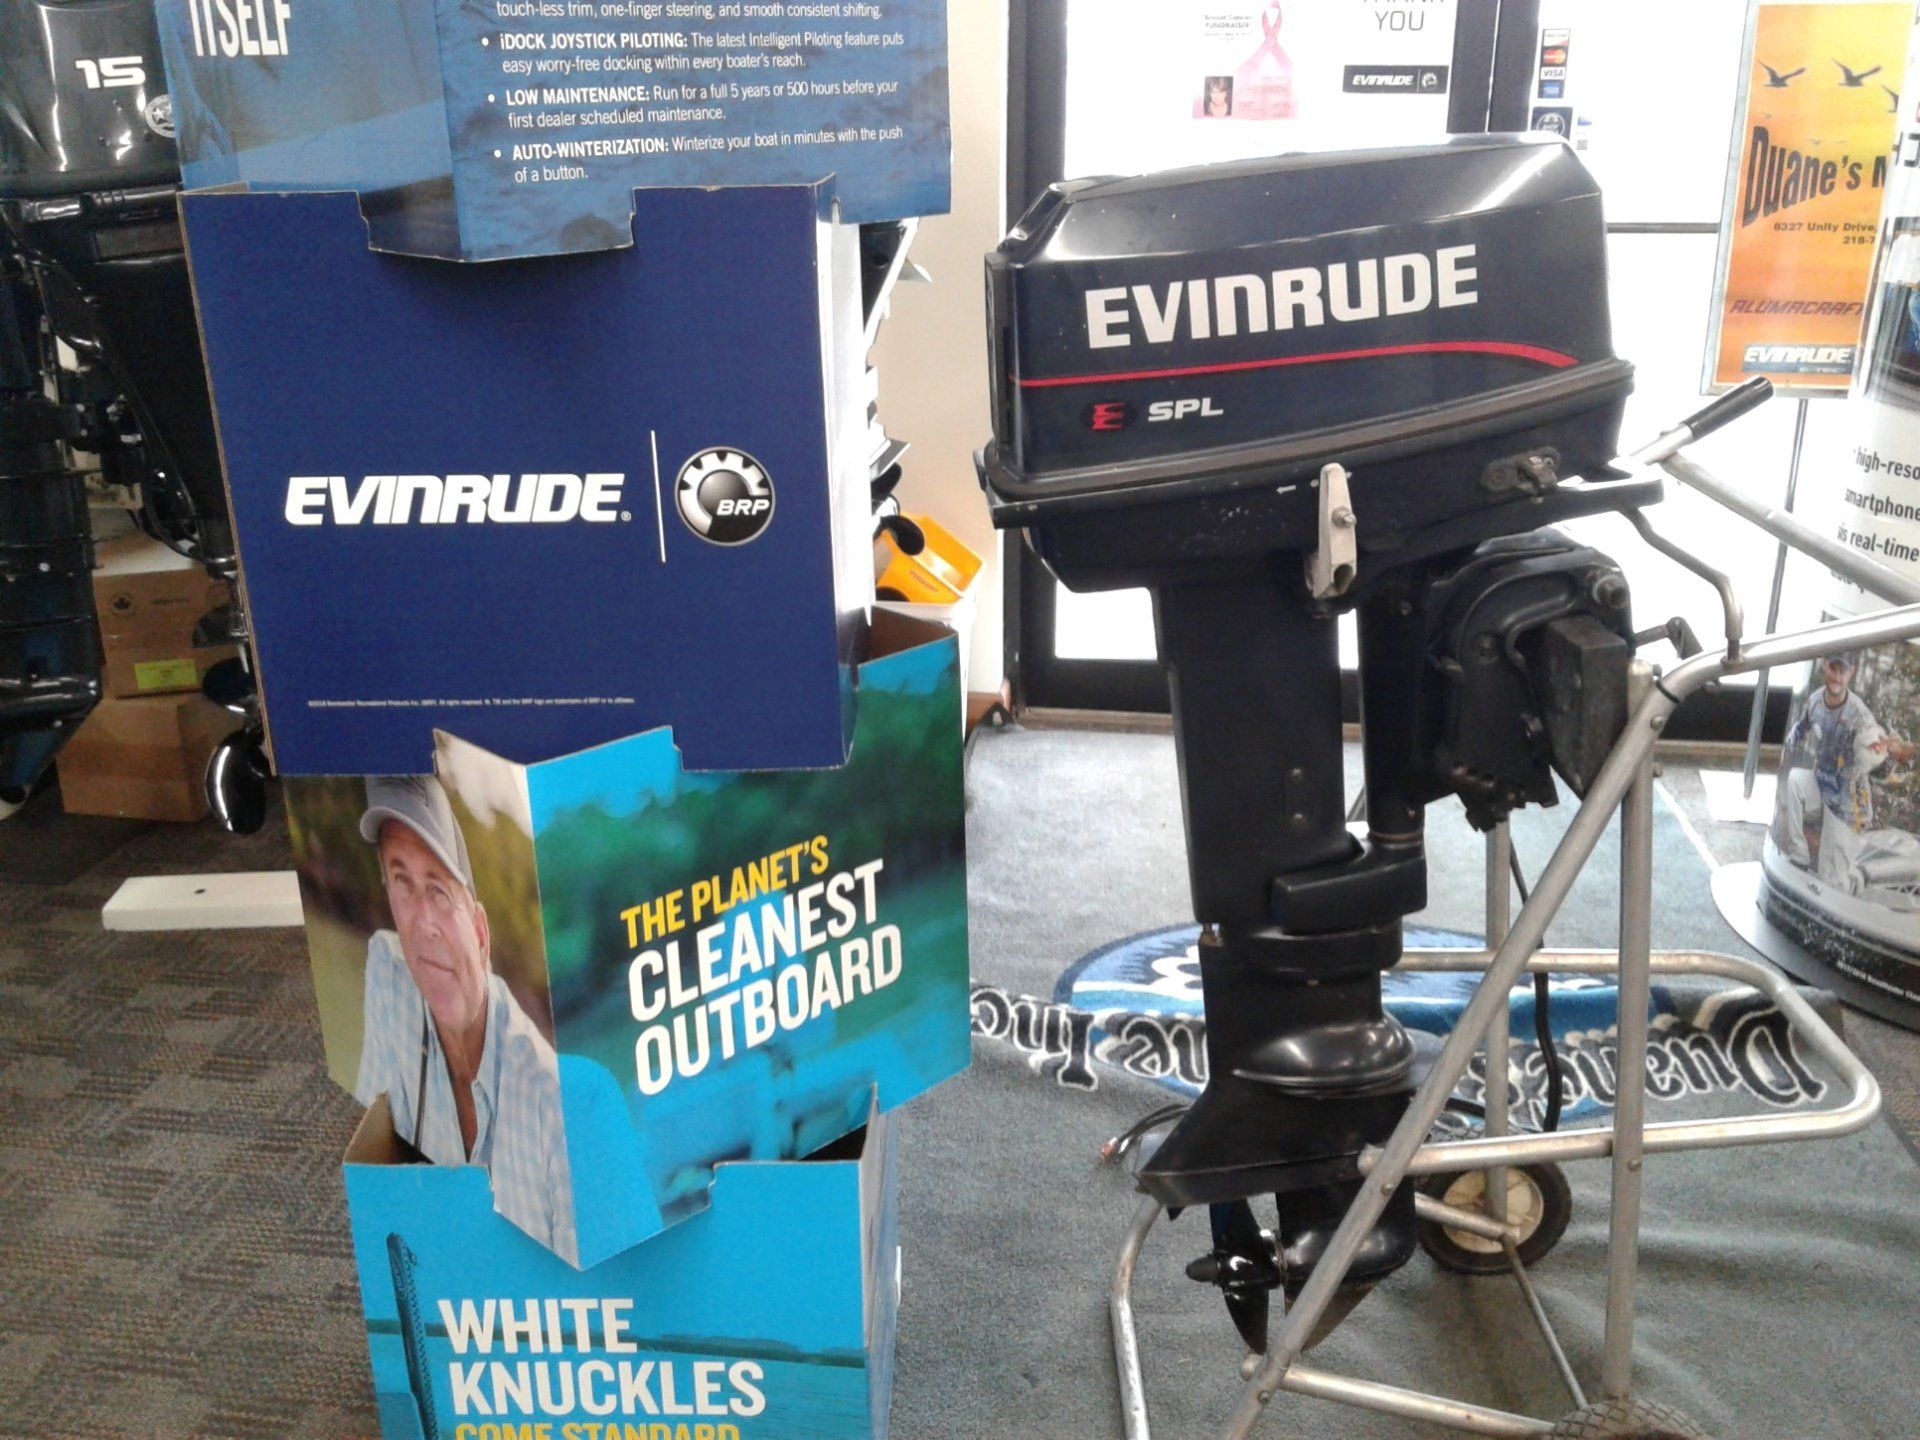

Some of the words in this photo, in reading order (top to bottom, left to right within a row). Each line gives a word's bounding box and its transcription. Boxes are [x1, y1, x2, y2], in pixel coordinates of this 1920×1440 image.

[497, 1, 564, 17] touch-less
[568, 2, 597, 18] trim,
[601, 1, 662, 19] one-finger
[666, 3, 715, 19] steering,
[719, 3, 740, 17] and
[744, 3, 784, 17] smooth
[787, 3, 840, 17] consistent
[843, 3, 882, 19] shifting.
[1375, 10, 1424, 31] YOU
[500, 33, 546, 50] iDOCK
[550, 33, 617, 49] JOYSTICK
[621, 32, 688, 48] PILOTING:
[691, 32, 713, 47] The
[716, 32, 746, 47] latest
[749, 32, 801, 49] Intelligent
[804, 31, 842, 49] Piloting
[844, 31, 880, 46] feature
[883, 33, 904, 47] puts
[75, 55, 146, 90] 15
[502, 59, 532, 76] easy
[536, 56, 600, 75] worry-free
[603, 56, 652, 73] docking
[655, 56, 690, 70] within
[693, 57, 723, 71] every
[726, 53, 769, 68] boater's
[773, 53, 806, 67] reach.
[1543, 69, 1563, 77] VISA
[1352, 74, 1414, 86] EVINRUDE
[506, 89, 538, 106] LOW
[543, 86, 650, 104] MAINTENANCE:
[654, 85, 678, 100] Run
[681, 84, 696, 100] for
[700, 88, 708, 99] a
[710, 84, 727, 99] full
[730, 83, 739, 98] 5
[741, 85, 770, 101] years
[773, 85, 784, 97] or
[787, 81, 809, 96] 500
[811, 81, 841, 95] hours
[843, 80, 875, 94] before
[876, 81, 899, 96] your
[508, 112, 534, 129] first
[536, 111, 577, 128] dealer
[580, 108, 644, 125] scheduled
[647, 107, 726, 122] maintenance.
[512, 137, 669, 161] AUTO-WINTERIZATION:
[671, 134, 725, 151] Winterize
[727, 136, 751, 152] your
[754, 132, 779, 147] boat
[781, 131, 791, 145] in
[794, 130, 836, 144] minutes
[837, 128, 859, 142] with
[860, 126, 877, 141] the
[879, 125, 903, 141] push
[515, 166, 527, 183] of
[531, 170, 540, 182] a
[543, 165, 589, 182] button.
[1742, 125, 1863, 229] Duane's
[1807, 222, 1839, 233] Unity
[1085, 244, 1478, 349] EVINRUDE
[1743, 346, 1851, 363] EVINRUDE
[1148, 397, 1224, 422] SPL
[717, 498, 770, 516] BRP
[1850, 532, 1920, 562] real-time
[620, 889, 685, 949] THE
[691, 835, 829, 923] PLANET'S
[628, 858, 883, 1022] CLEANEST
[635, 924, 902, 1096] OUTBOARD
[438, 1298, 638, 1354] WHITE
[449, 1359, 766, 1417] KNUCKLES
